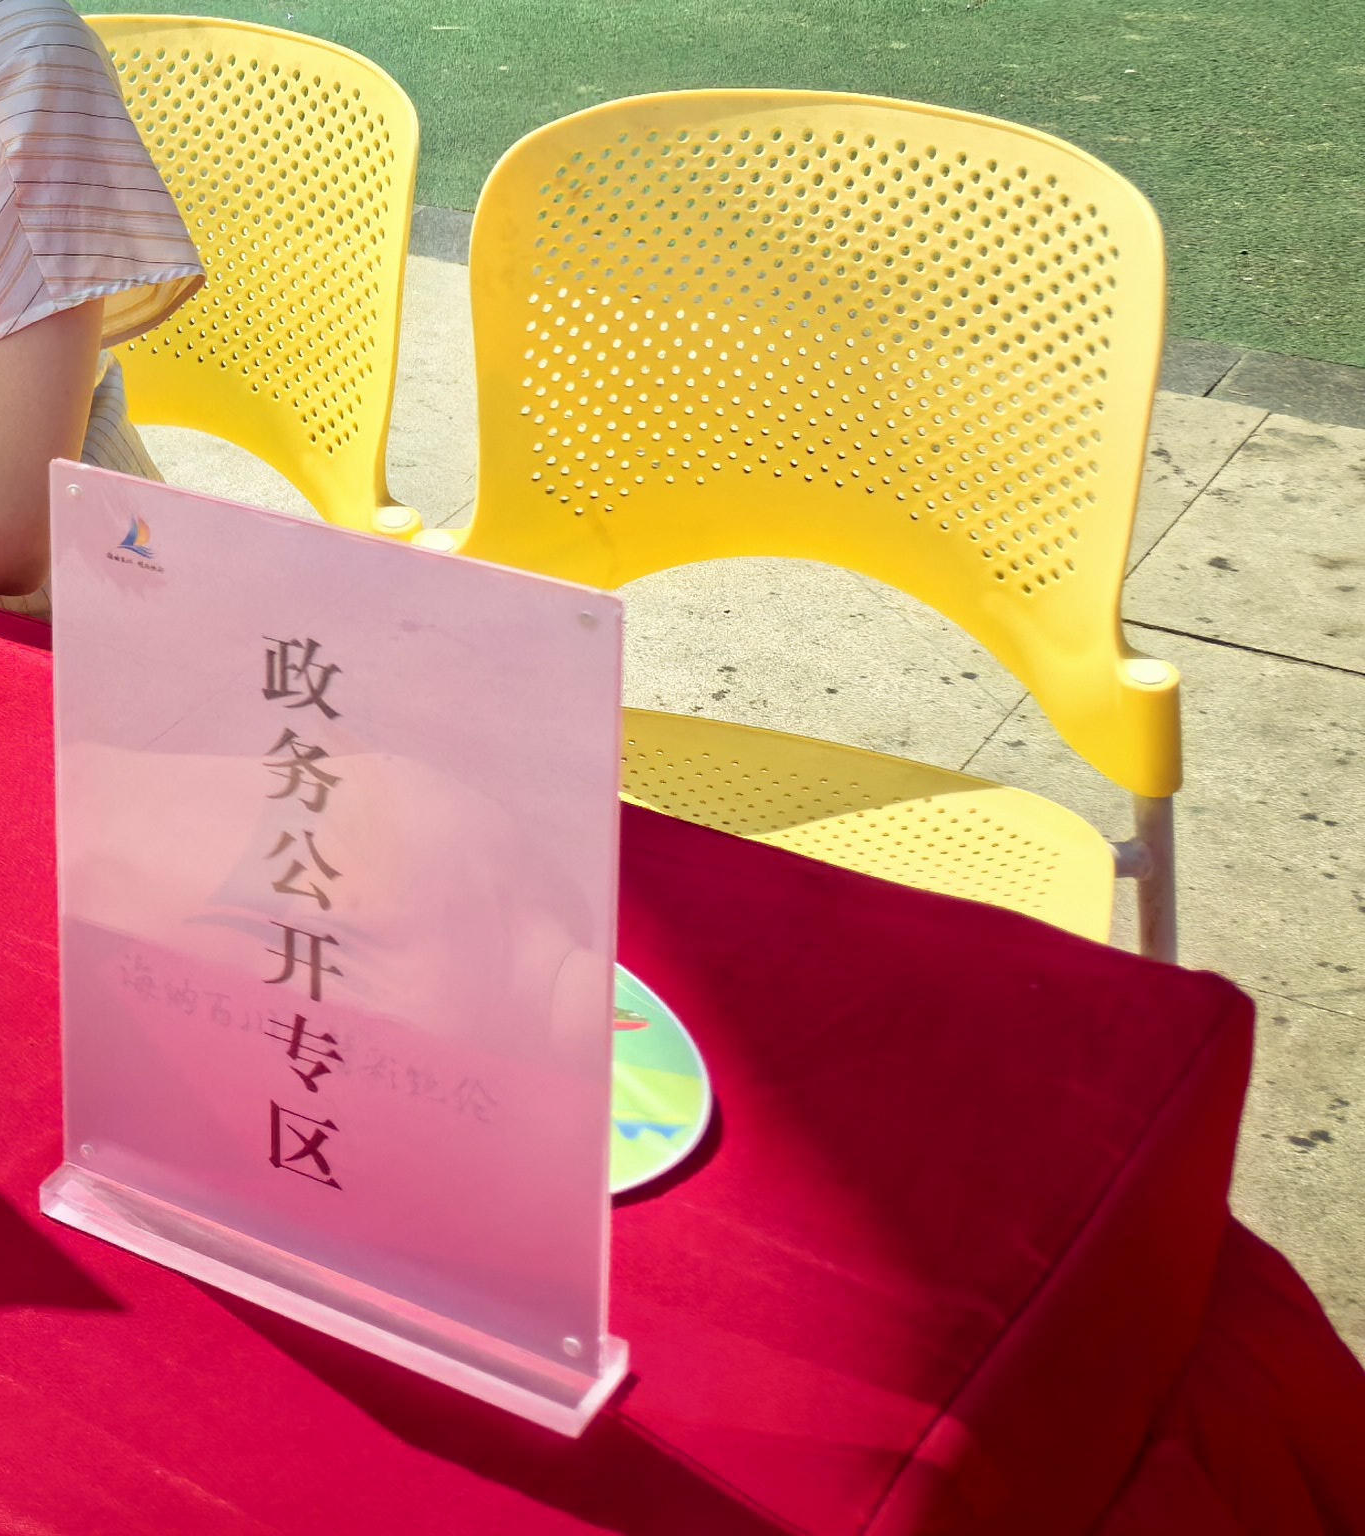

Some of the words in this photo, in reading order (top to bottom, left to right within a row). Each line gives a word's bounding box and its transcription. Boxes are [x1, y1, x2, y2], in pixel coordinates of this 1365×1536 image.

[261, 633, 345, 1192] 政务公开专区
